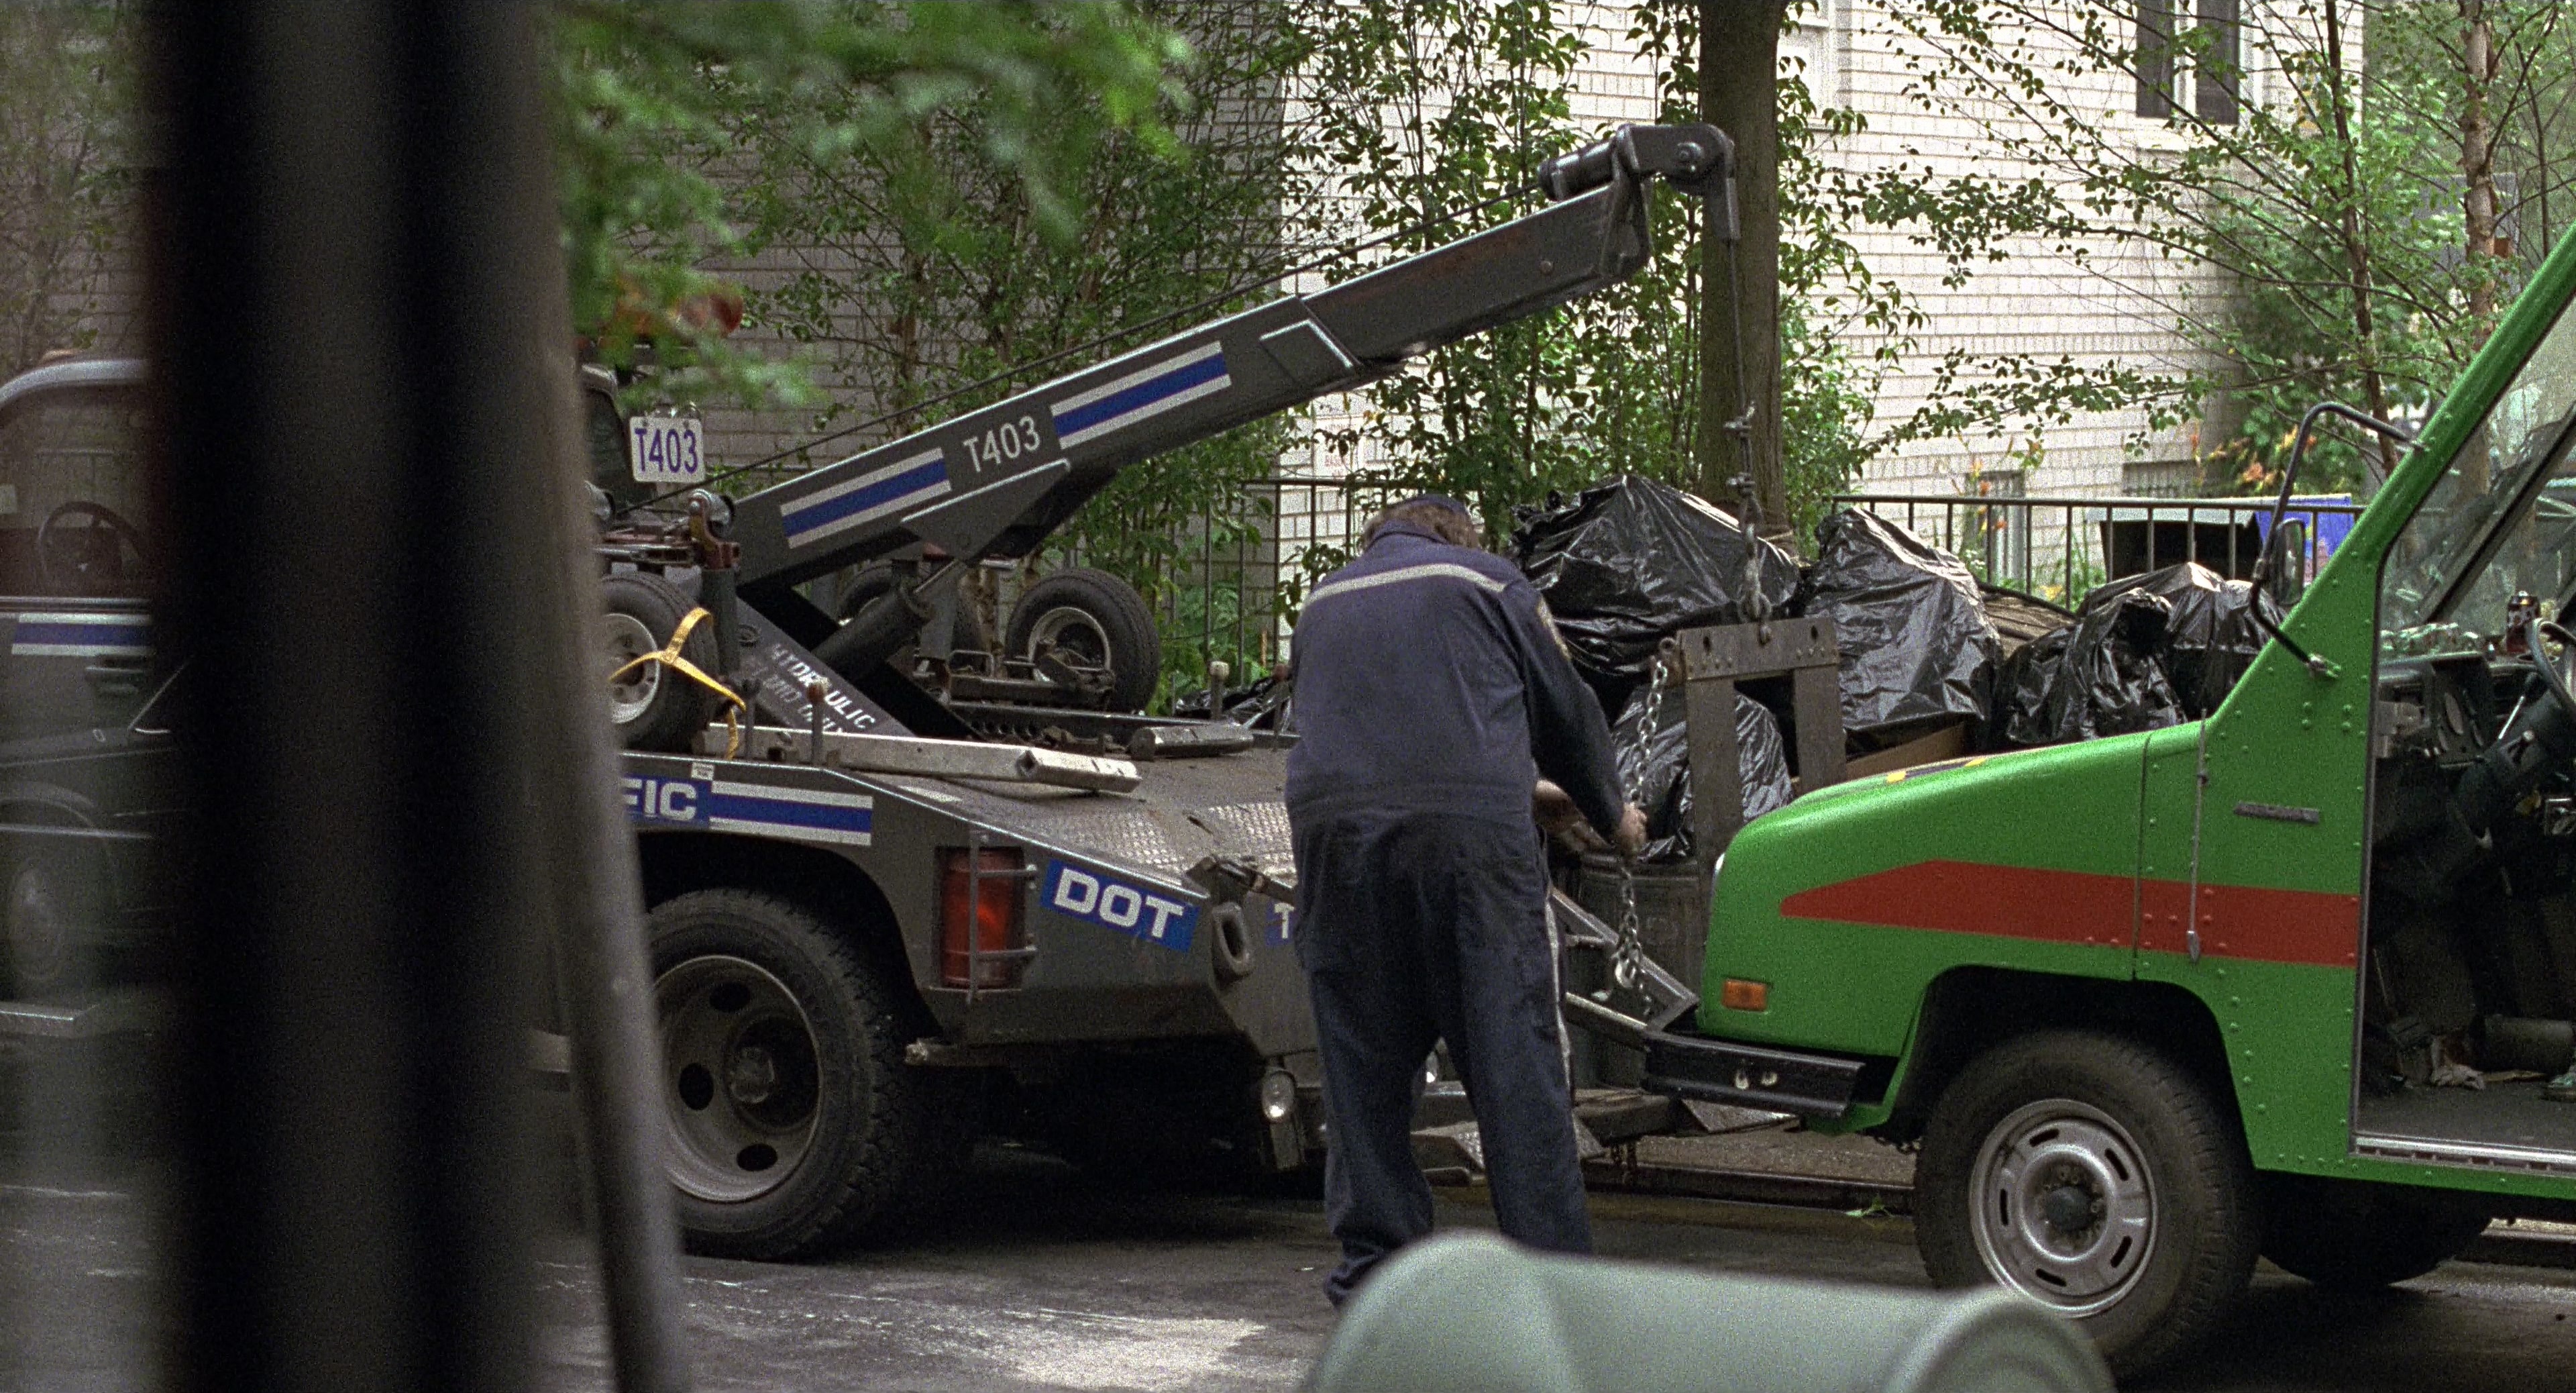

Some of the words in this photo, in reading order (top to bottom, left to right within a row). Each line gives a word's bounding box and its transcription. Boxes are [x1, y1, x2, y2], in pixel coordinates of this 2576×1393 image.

[635, 428, 698, 474] T403
[963, 416, 1040, 472] T403
[771, 643, 875, 729] HYDRULIC
[1054, 868, 1183, 939] DOT
